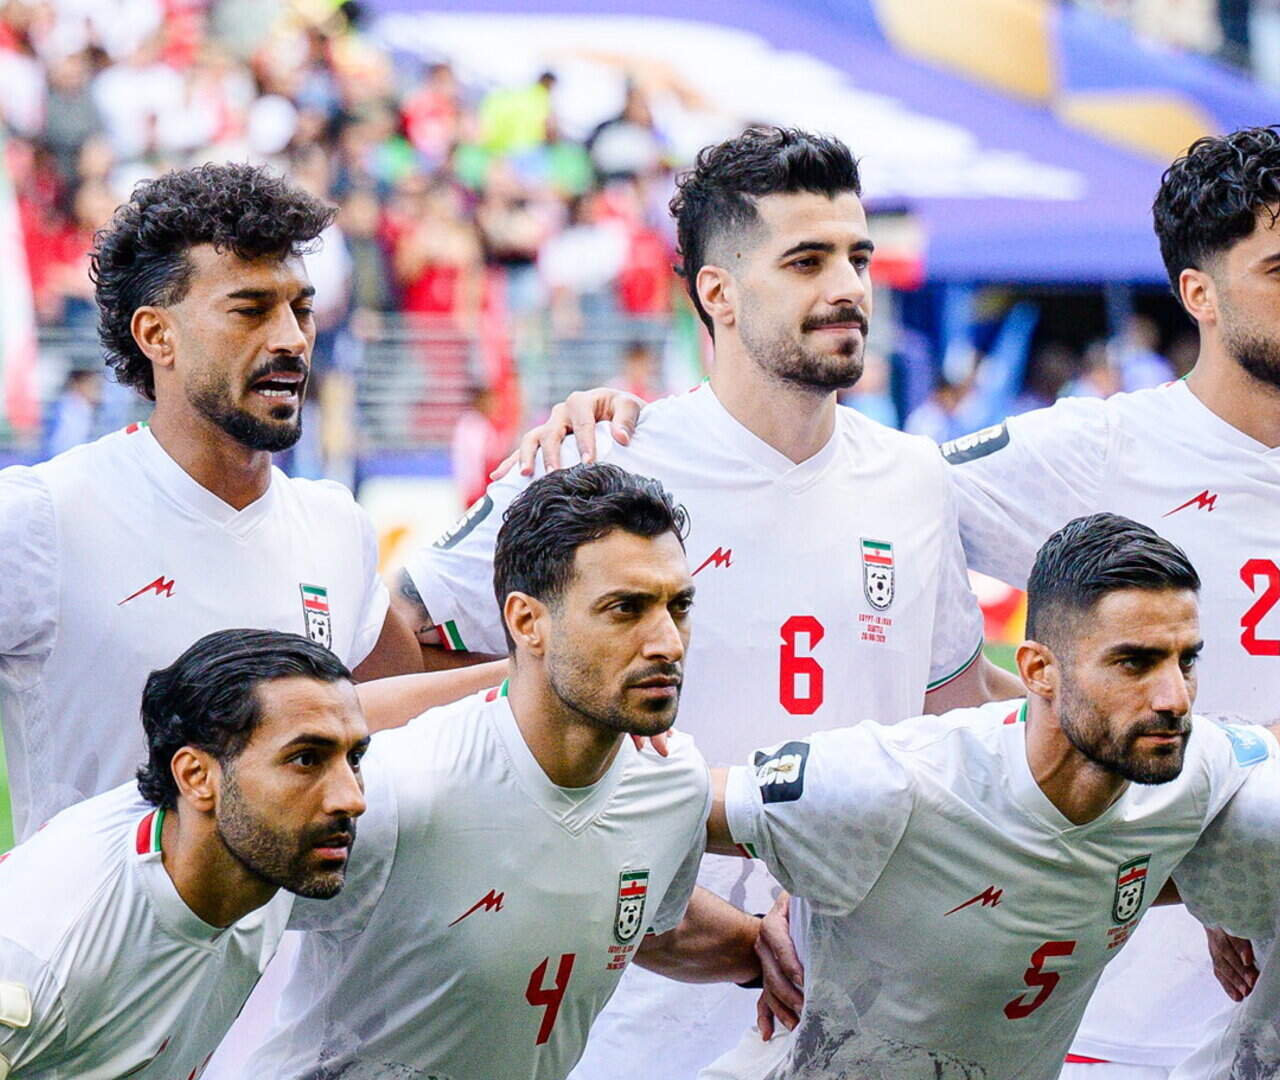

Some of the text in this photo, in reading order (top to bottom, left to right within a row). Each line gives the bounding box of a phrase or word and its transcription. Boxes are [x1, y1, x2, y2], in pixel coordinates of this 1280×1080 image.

[780, 615, 825, 715] 6
[525, 953, 576, 1046] 4
[1003, 940, 1077, 1020] 5
